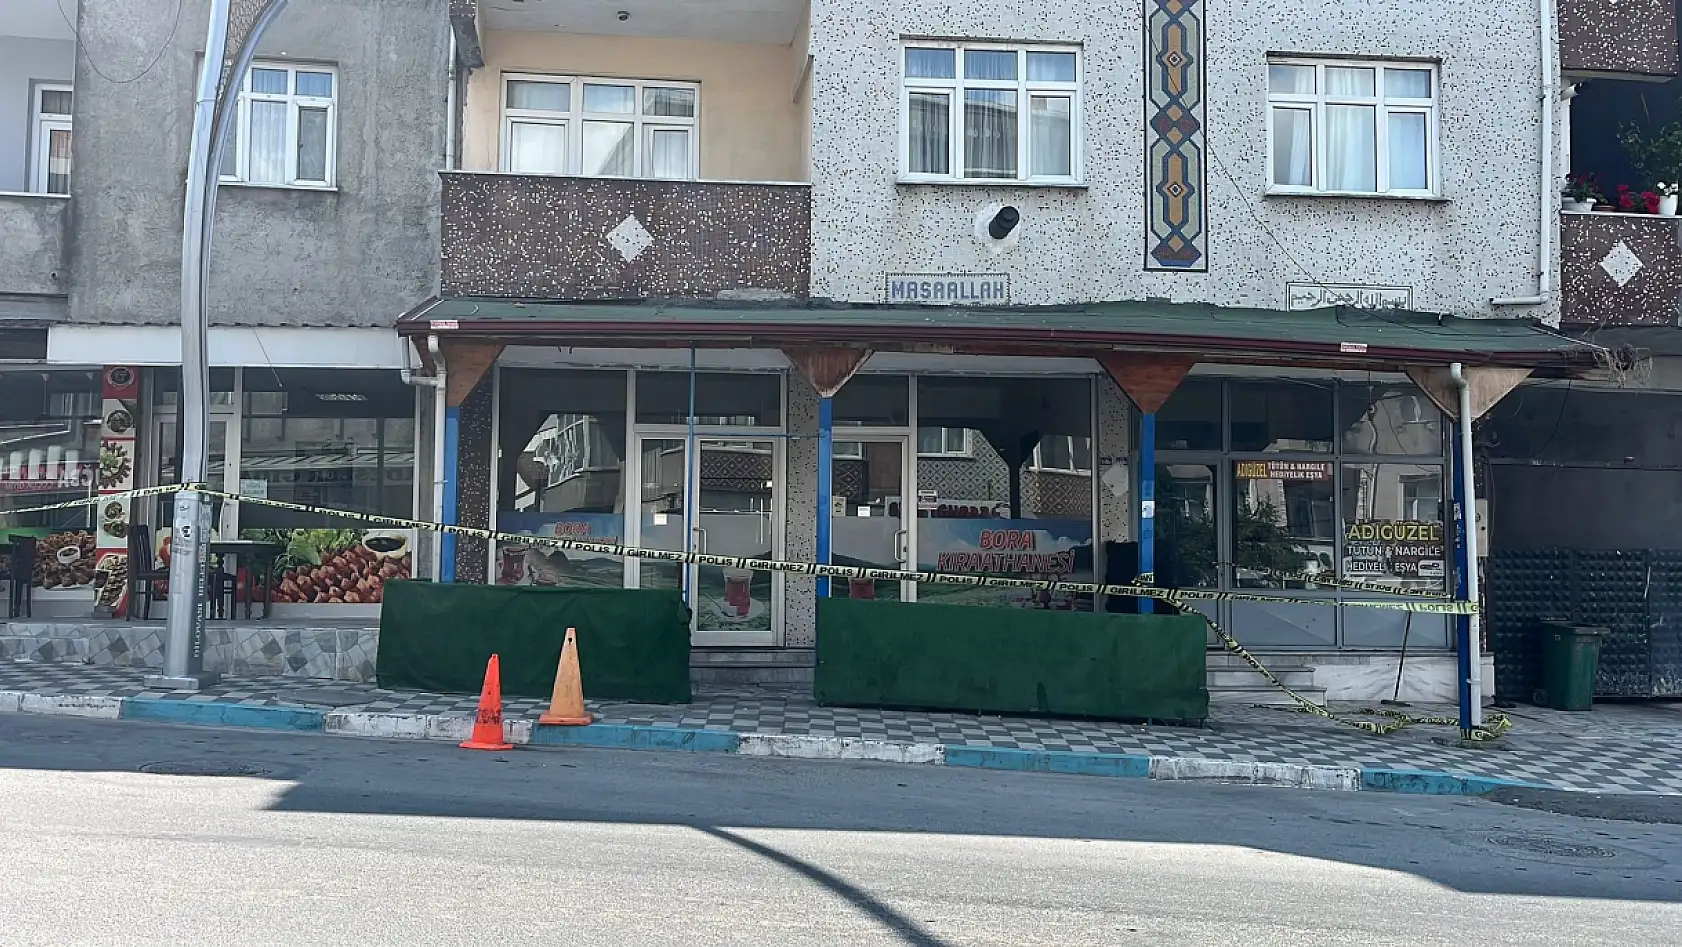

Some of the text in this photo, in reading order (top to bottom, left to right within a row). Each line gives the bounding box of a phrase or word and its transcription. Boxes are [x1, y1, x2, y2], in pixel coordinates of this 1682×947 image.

[891, 280, 1004, 299] MASAALLAH
[979, 528, 1035, 549] BORA
[1348, 521, 1440, 541] ADIGÜZEL
